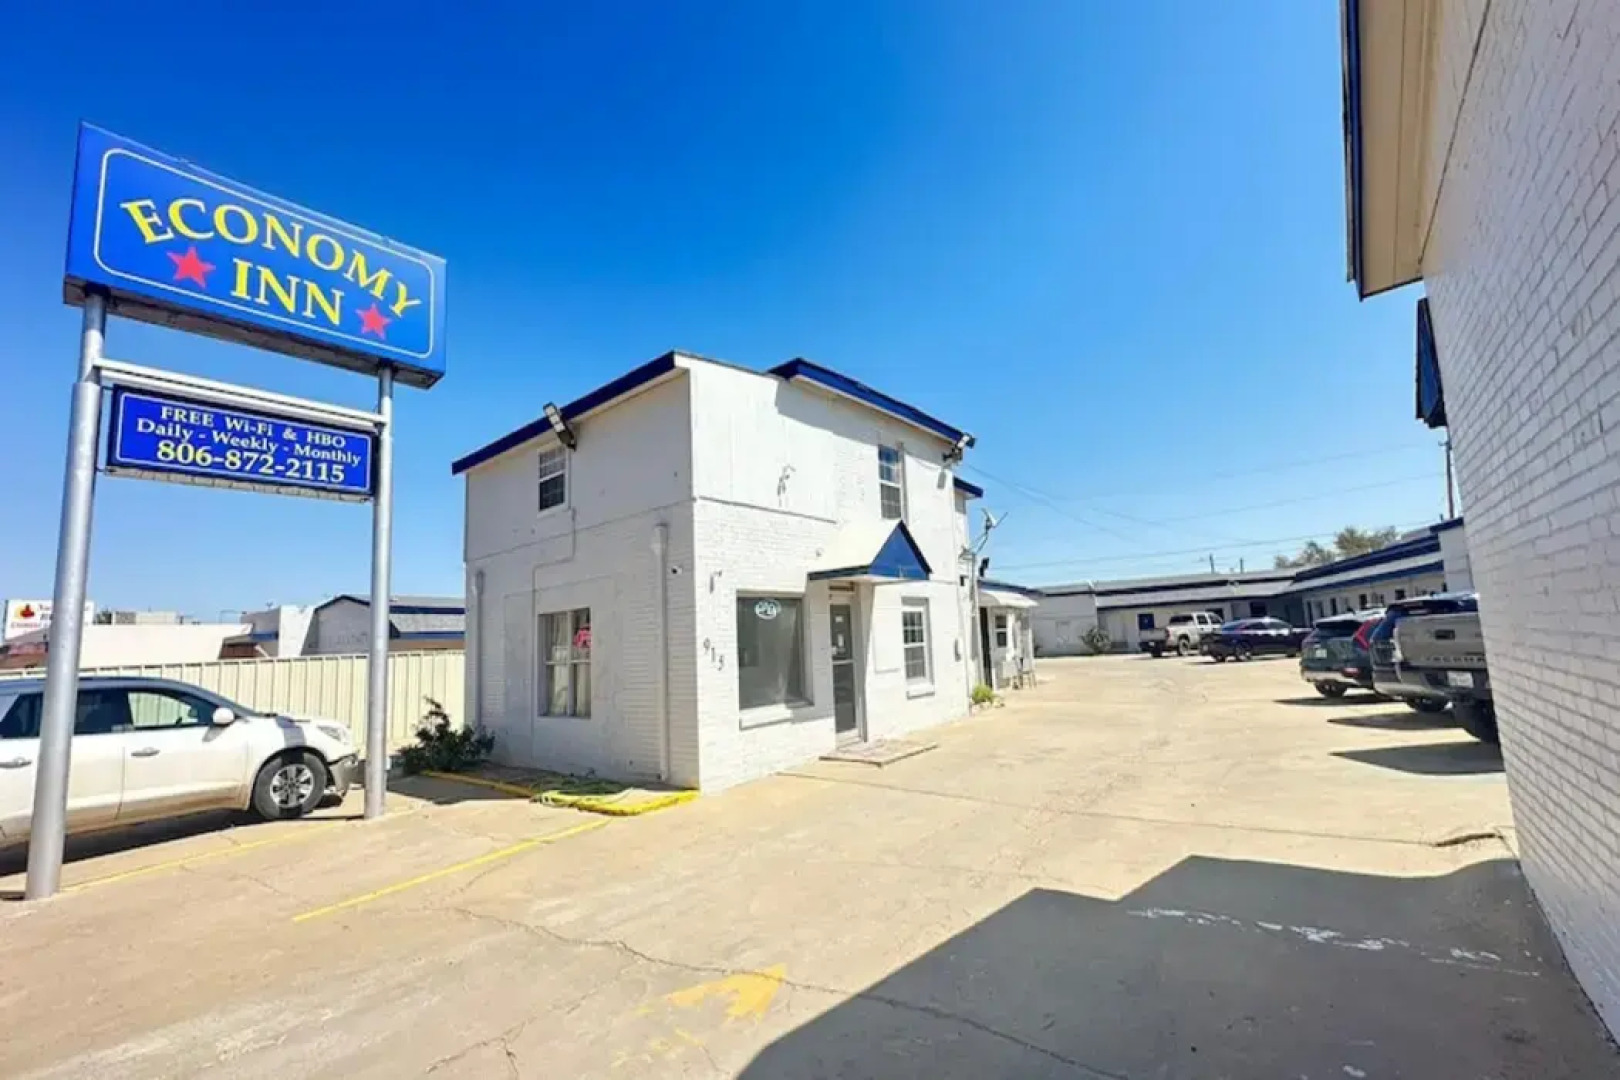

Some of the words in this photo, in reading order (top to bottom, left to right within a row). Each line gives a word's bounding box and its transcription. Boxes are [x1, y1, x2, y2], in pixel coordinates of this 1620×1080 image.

[120, 198, 421, 318] ECONOMY
[231, 258, 344, 325] INN
[137, 417, 194, 441] Daily
[212, 429, 279, 455] Weekly
[294, 443, 361, 467] Monthly
[161, 405, 214, 428] FREE
[225, 416, 273, 436] Wi-Fi
[282, 427, 297, 441] &
[306, 431, 346, 448] HBO
[157, 439, 345, 483] 806-872-2115
